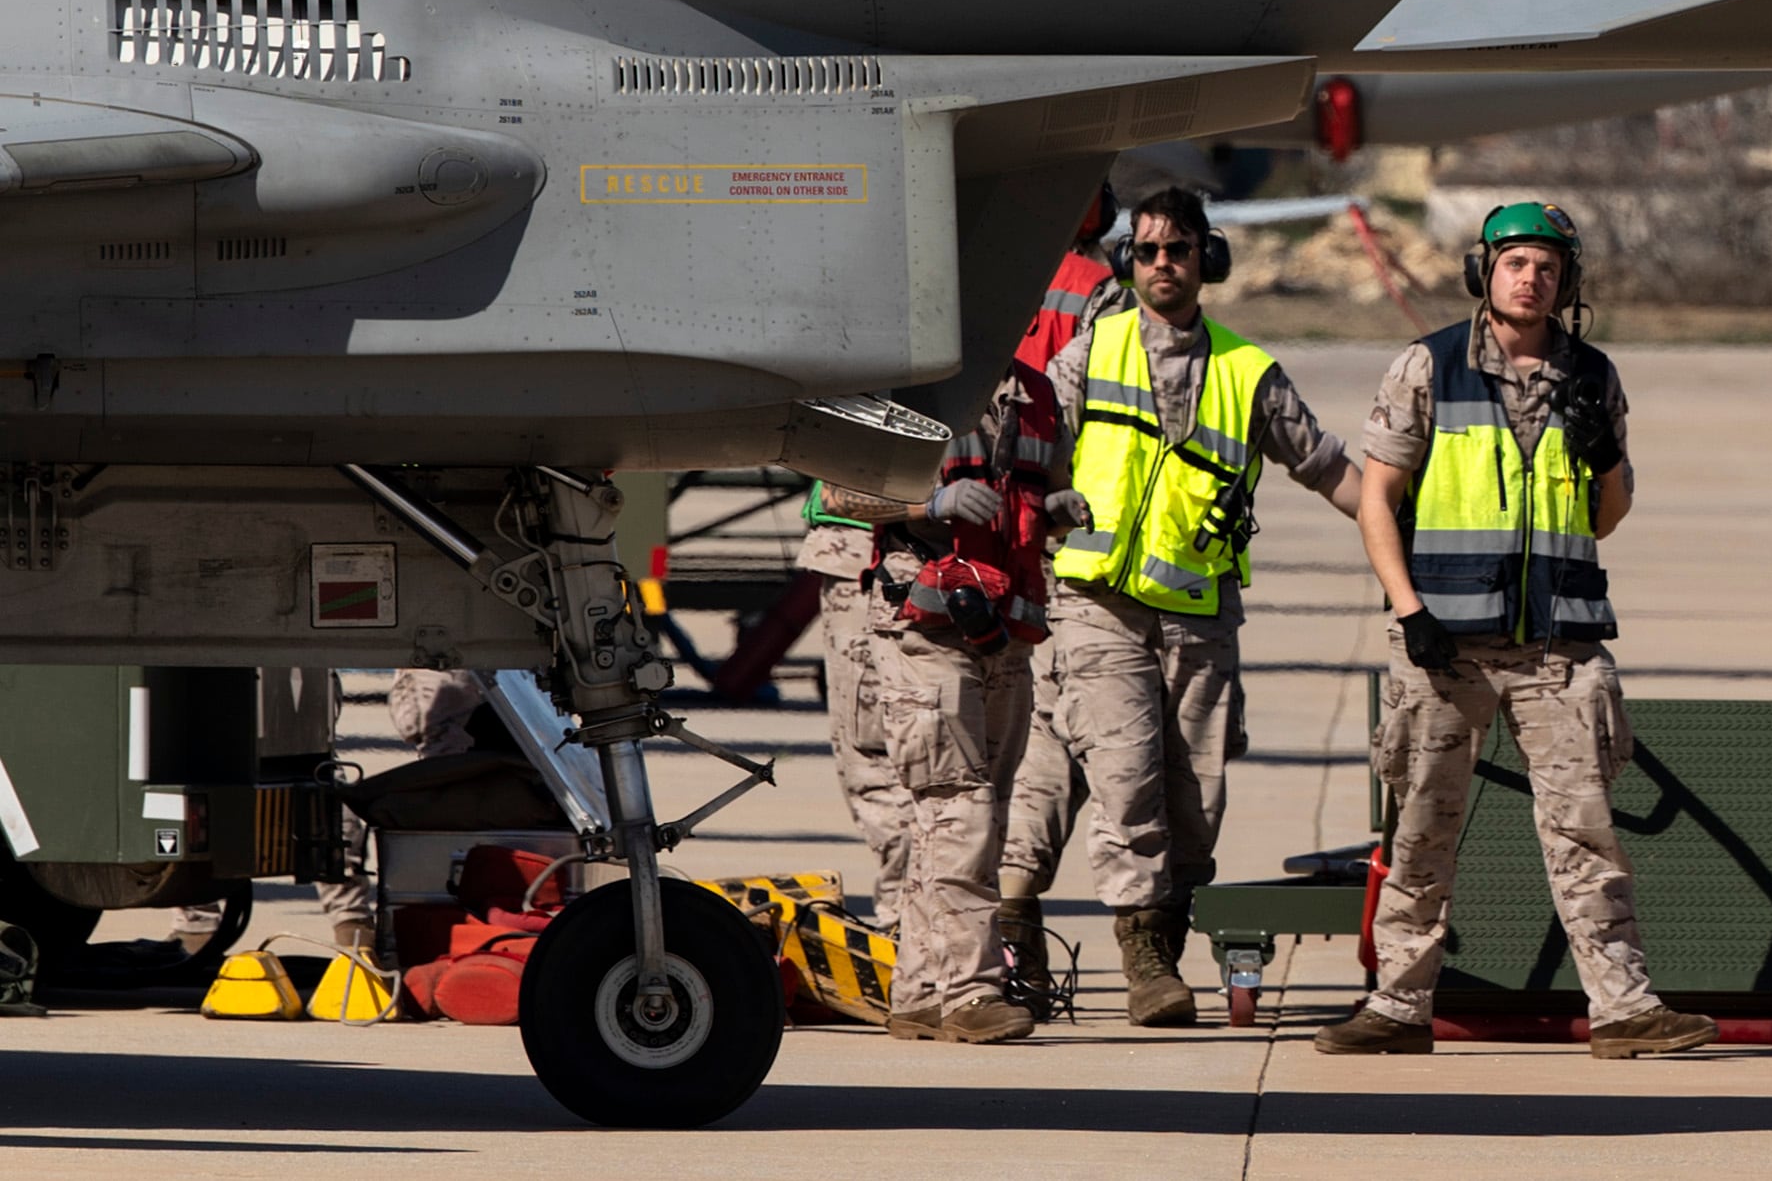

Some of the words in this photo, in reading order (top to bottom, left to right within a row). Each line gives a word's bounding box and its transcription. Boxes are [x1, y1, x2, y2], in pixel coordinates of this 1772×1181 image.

[732, 172, 791, 182] EMERGENCY
[794, 172, 845, 182] ENTRANCE
[607, 175, 704, 194] RESCUE
[729, 186, 774, 196] CONTROL
[776, 186, 791, 196] ON
[793, 186, 824, 196] OTHER
[827, 186, 848, 196] SIDE
